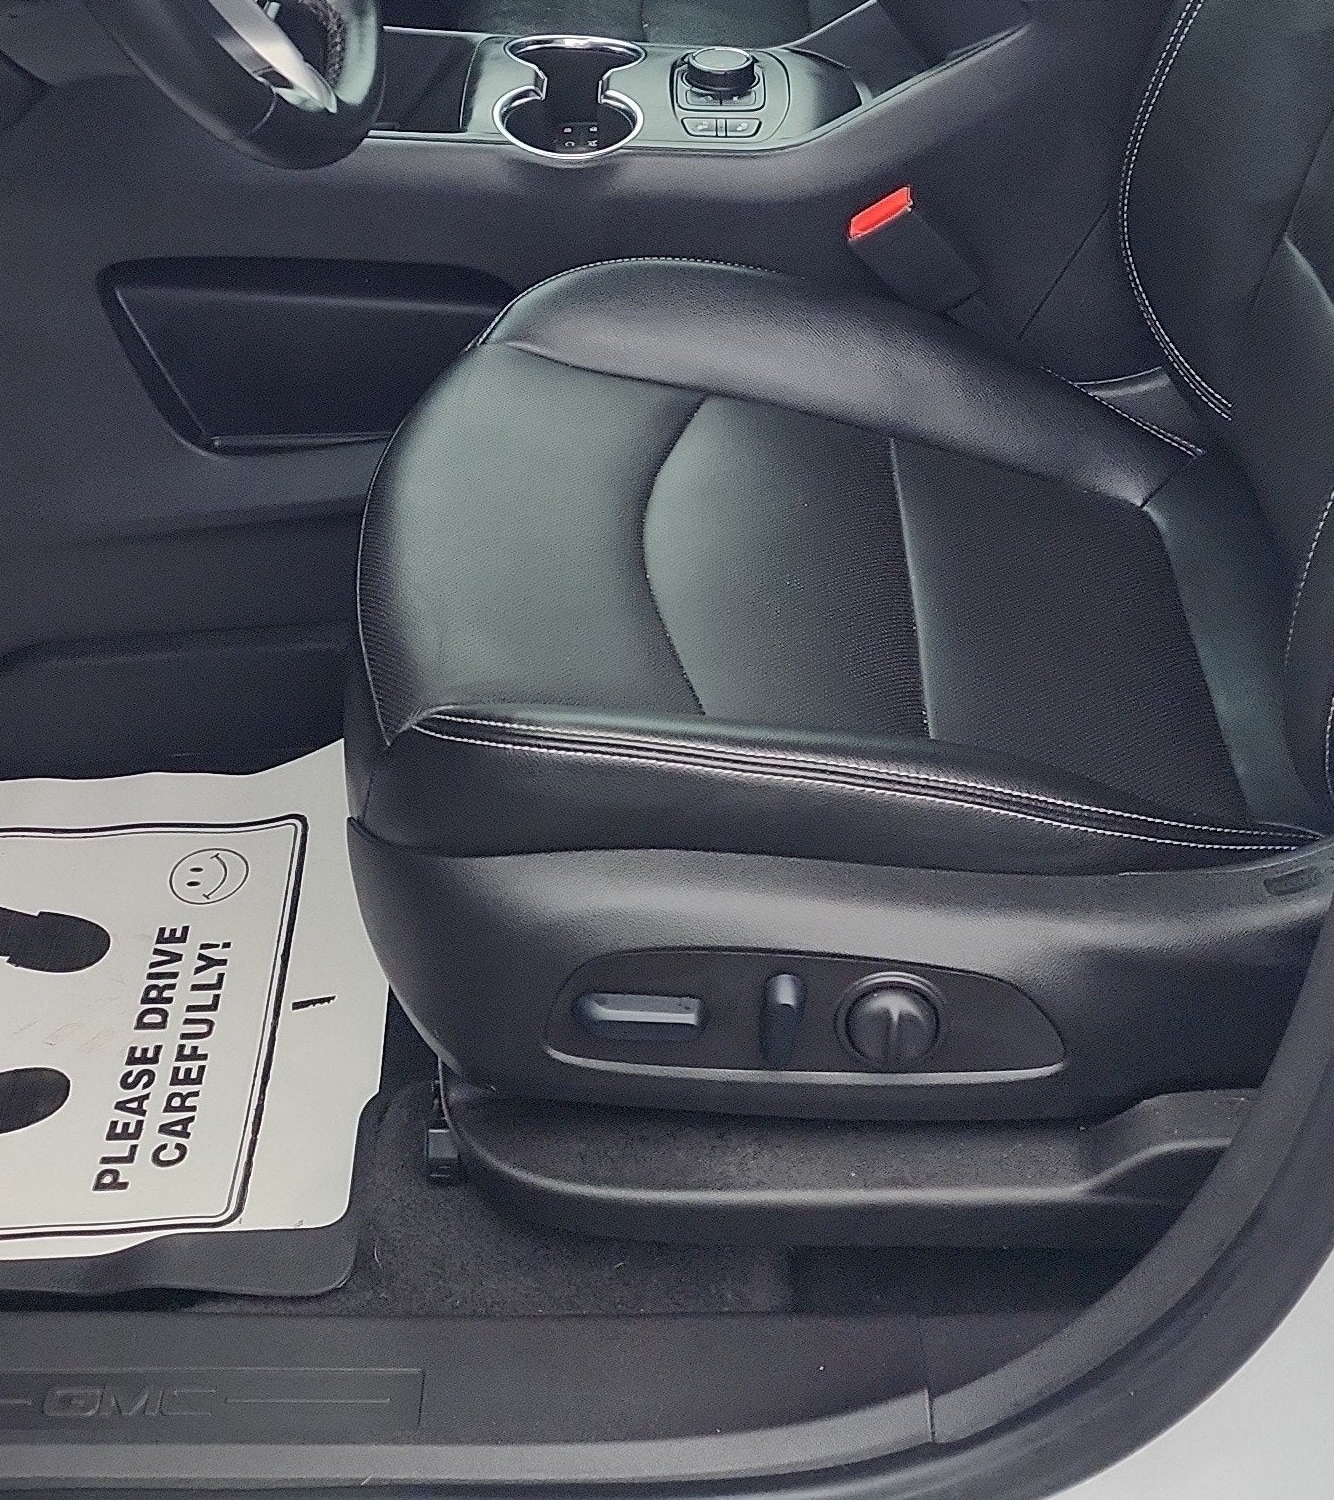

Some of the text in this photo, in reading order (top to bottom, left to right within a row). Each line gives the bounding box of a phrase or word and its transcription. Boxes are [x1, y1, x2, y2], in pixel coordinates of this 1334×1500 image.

[93, 926, 190, 1191] PLEASE DRIVE
[152, 943, 228, 1167] CAREFULLY!
[42, 1386, 217, 1416] GMC
